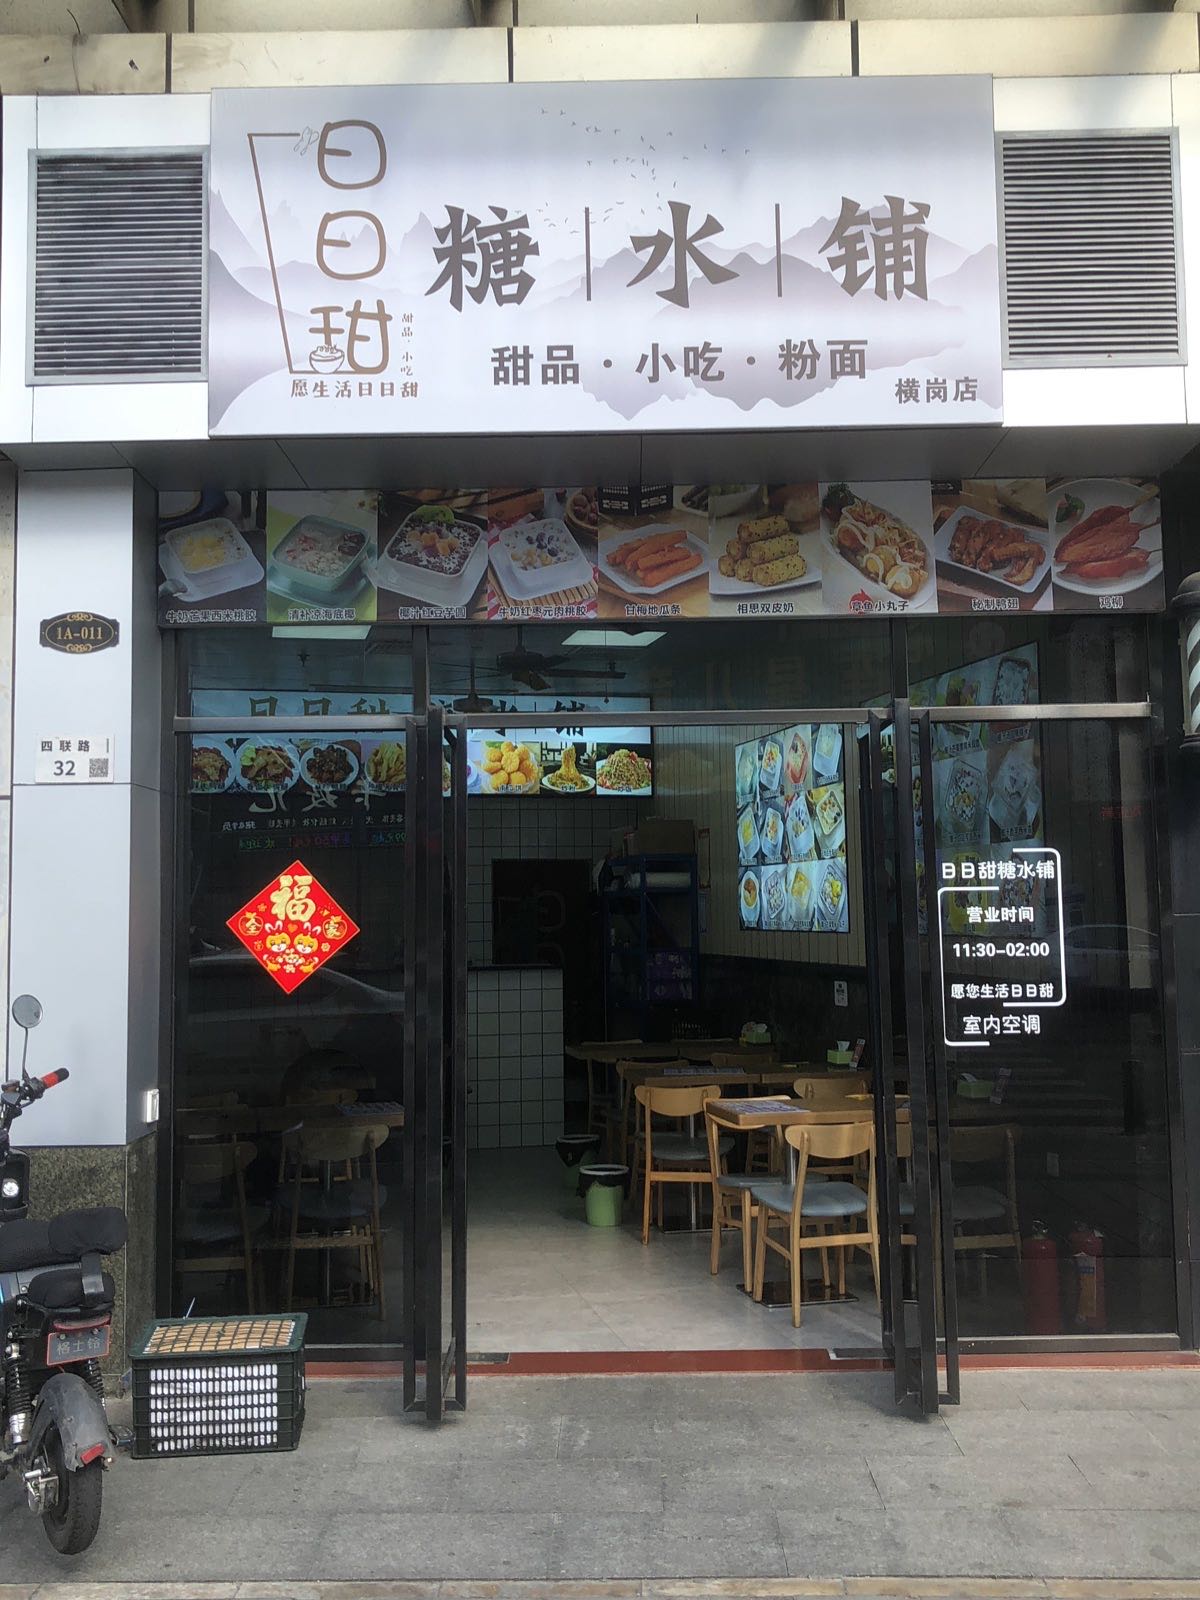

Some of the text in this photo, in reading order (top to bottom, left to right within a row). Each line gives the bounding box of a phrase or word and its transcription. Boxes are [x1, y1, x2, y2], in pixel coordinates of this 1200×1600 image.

[290, 378, 419, 399] 愿生活日日甜
[895, 376, 979, 405] 横岗店
[398, 605, 467, 620] 椰汁红豆芋圆
[498, 604, 588, 618] 牛奶红枣元肉桃胶
[625, 603, 681, 617] 甘梅地瓜条
[736, 602, 794, 614] 相思双皮奶
[850, 599, 910, 613] 章鱼小丸子
[165, 608, 257, 624] 牛奶芒果西米桃胶
[56, 626, 103, 641] 1A-011
[41, 739, 91, 753] 四联路
[53, 759, 77, 777] 32
[941, 860, 1056, 880] 日日甜糖水铺
[270, 874, 316, 922] 福
[966, 905, 1035, 924] 营业时间
[952, 941, 1050, 958] 11:30-02:00
[950, 983, 1054, 999] 愿您生活日日甜
[962, 1014, 1041, 1036] 室内空调
